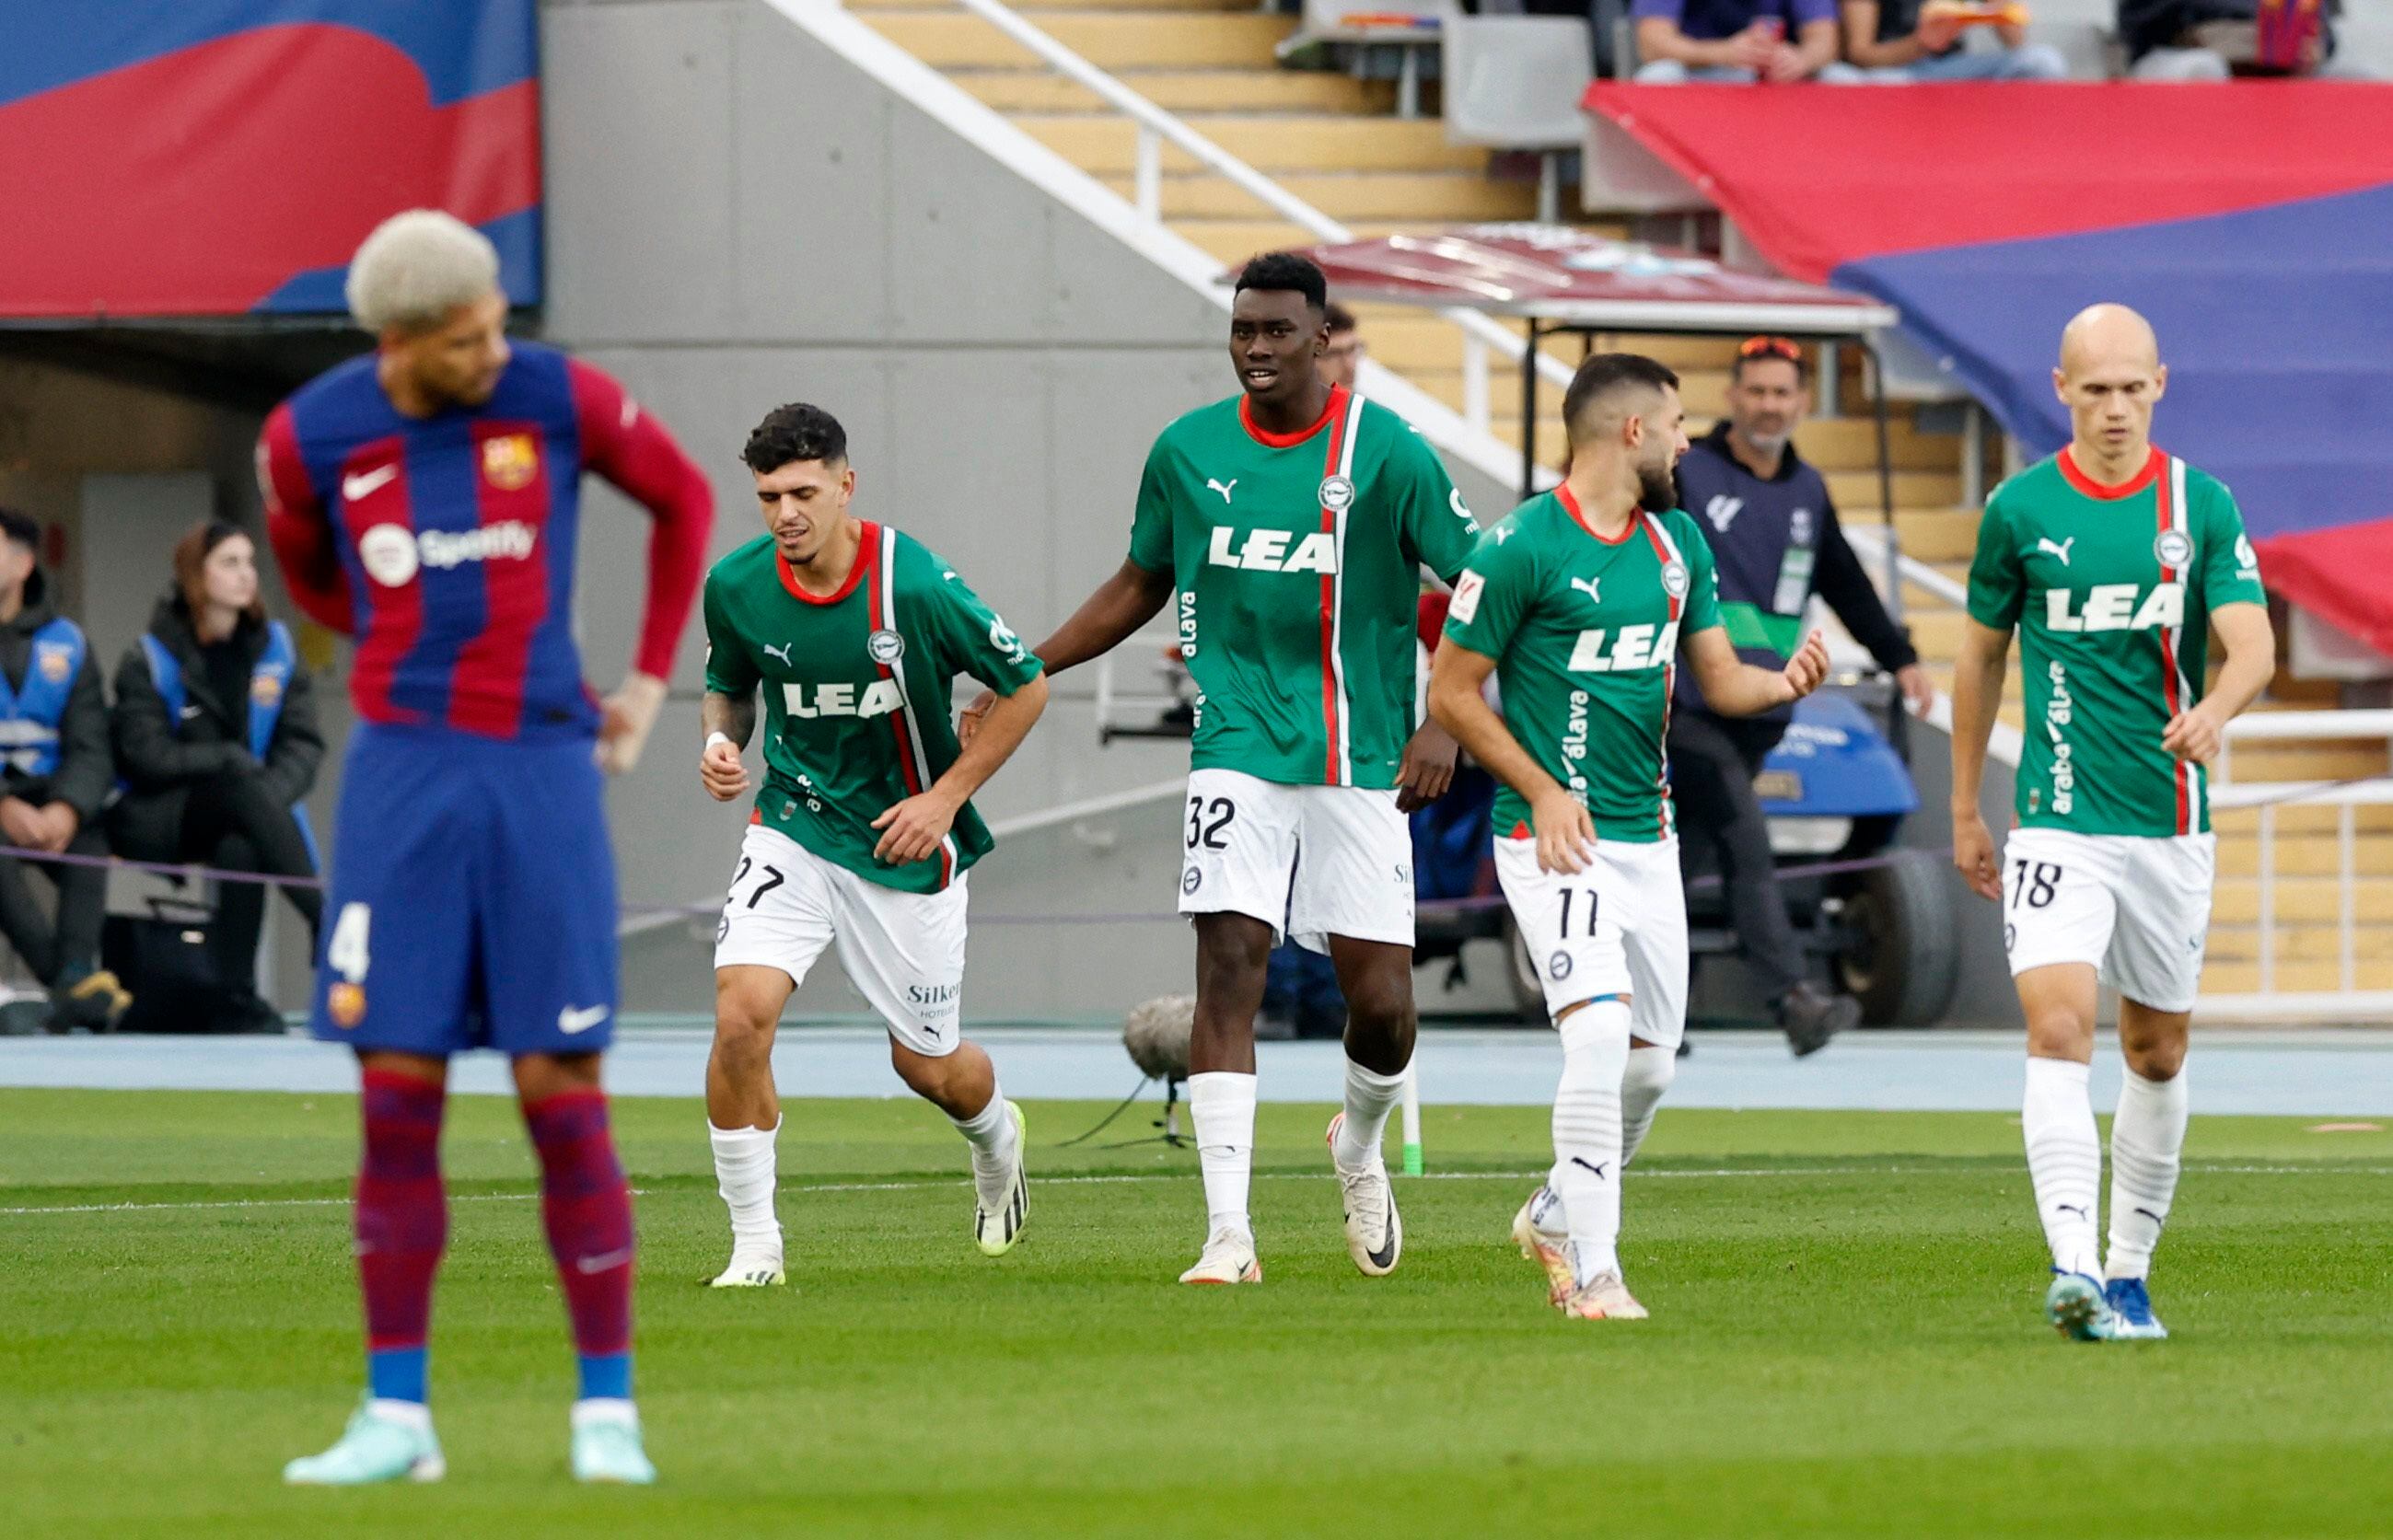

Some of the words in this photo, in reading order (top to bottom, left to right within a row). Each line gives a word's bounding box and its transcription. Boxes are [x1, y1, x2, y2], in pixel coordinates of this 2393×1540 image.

[1208, 526, 1339, 574] LEA
[2046, 583, 2186, 632] LEA
[1567, 621, 1680, 672] LEA
[783, 677, 905, 719] LEA
[1186, 795, 1236, 850] 32
[726, 856, 784, 909] 27
[2013, 860, 2062, 909] 18
[1558, 887, 1598, 939] 11
[327, 901, 371, 984] 4
